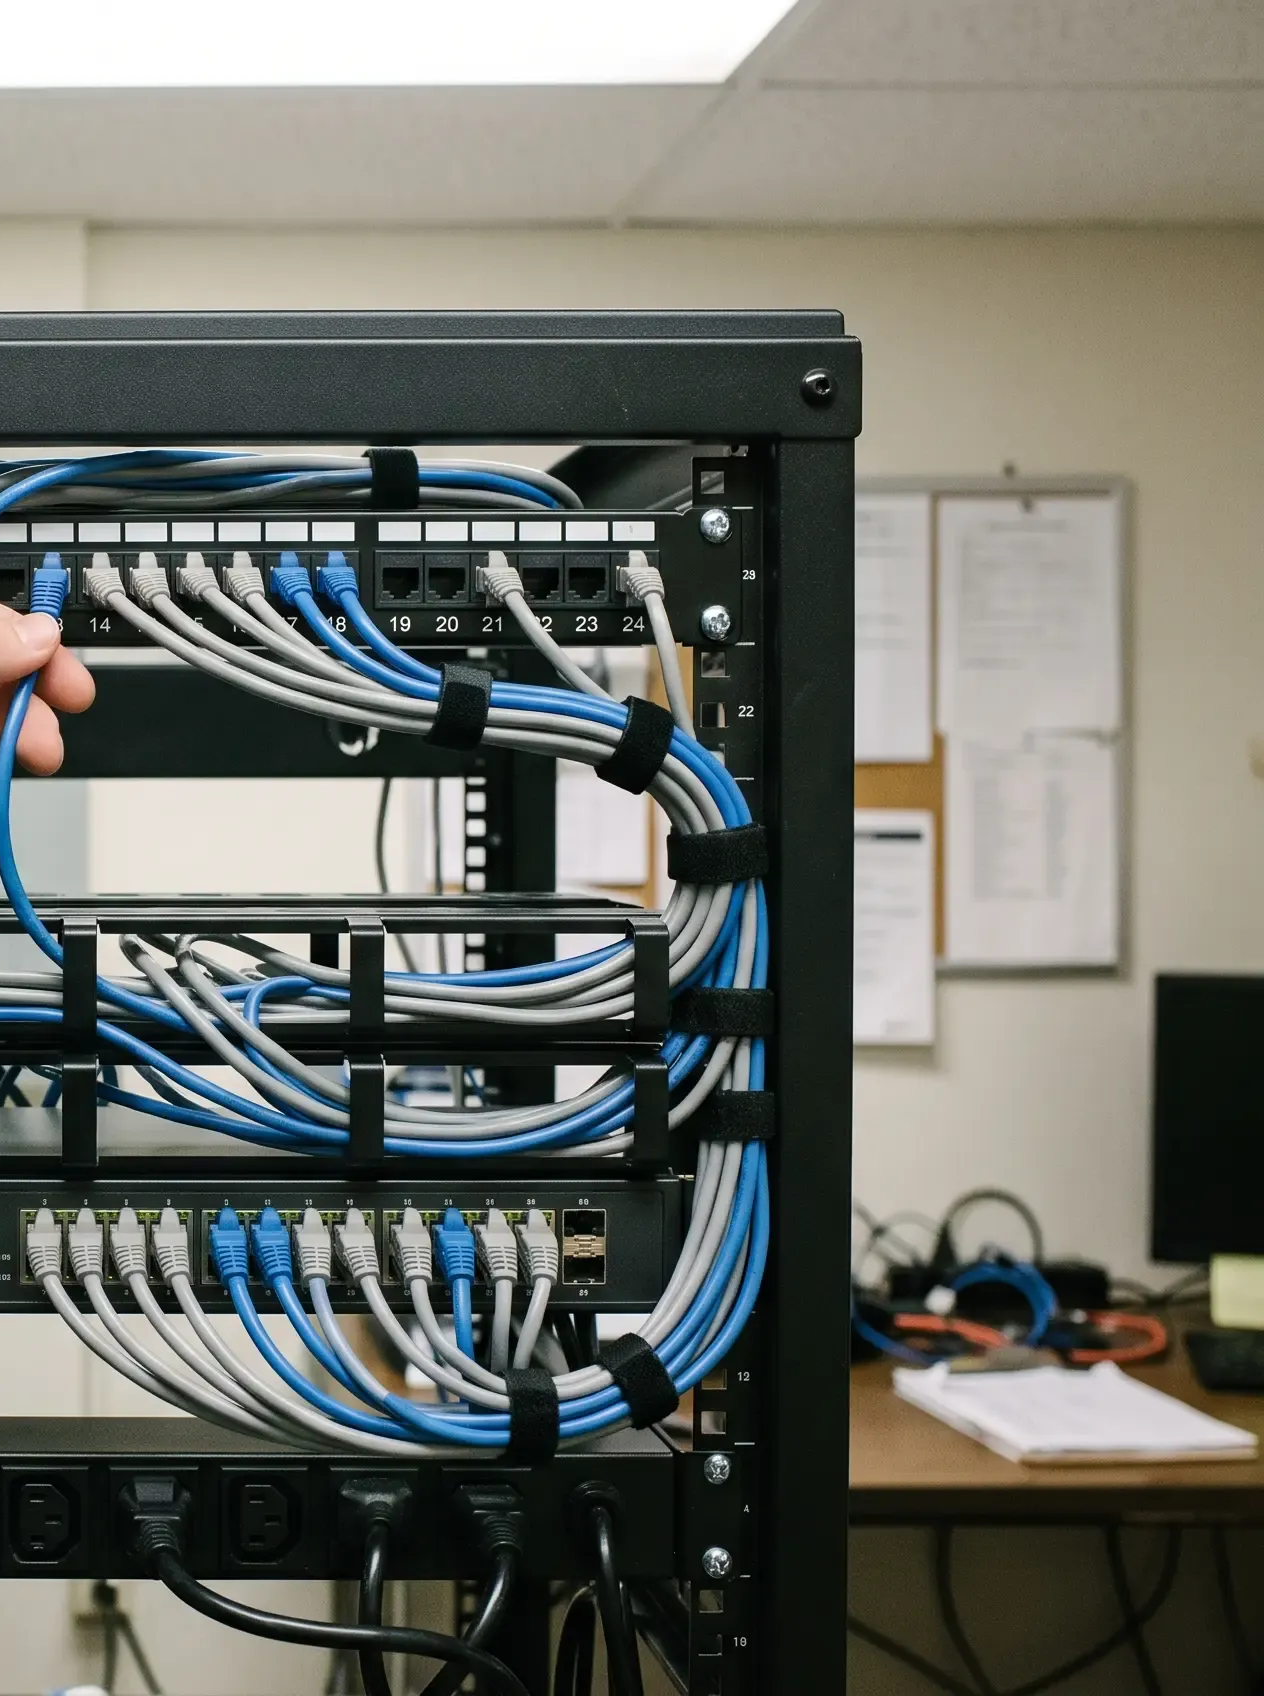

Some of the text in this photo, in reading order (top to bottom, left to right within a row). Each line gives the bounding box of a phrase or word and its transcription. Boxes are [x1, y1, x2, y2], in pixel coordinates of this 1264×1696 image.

[89, 617, 111, 633] 14
[389, 615, 412, 633] 19
[435, 615, 459, 633] 20
[482, 616, 503, 632] 21
[575, 615, 599, 632] 23
[622, 615, 645, 632] 24
[737, 705, 755, 718] 22
[737, 1371, 750, 1382] 12
